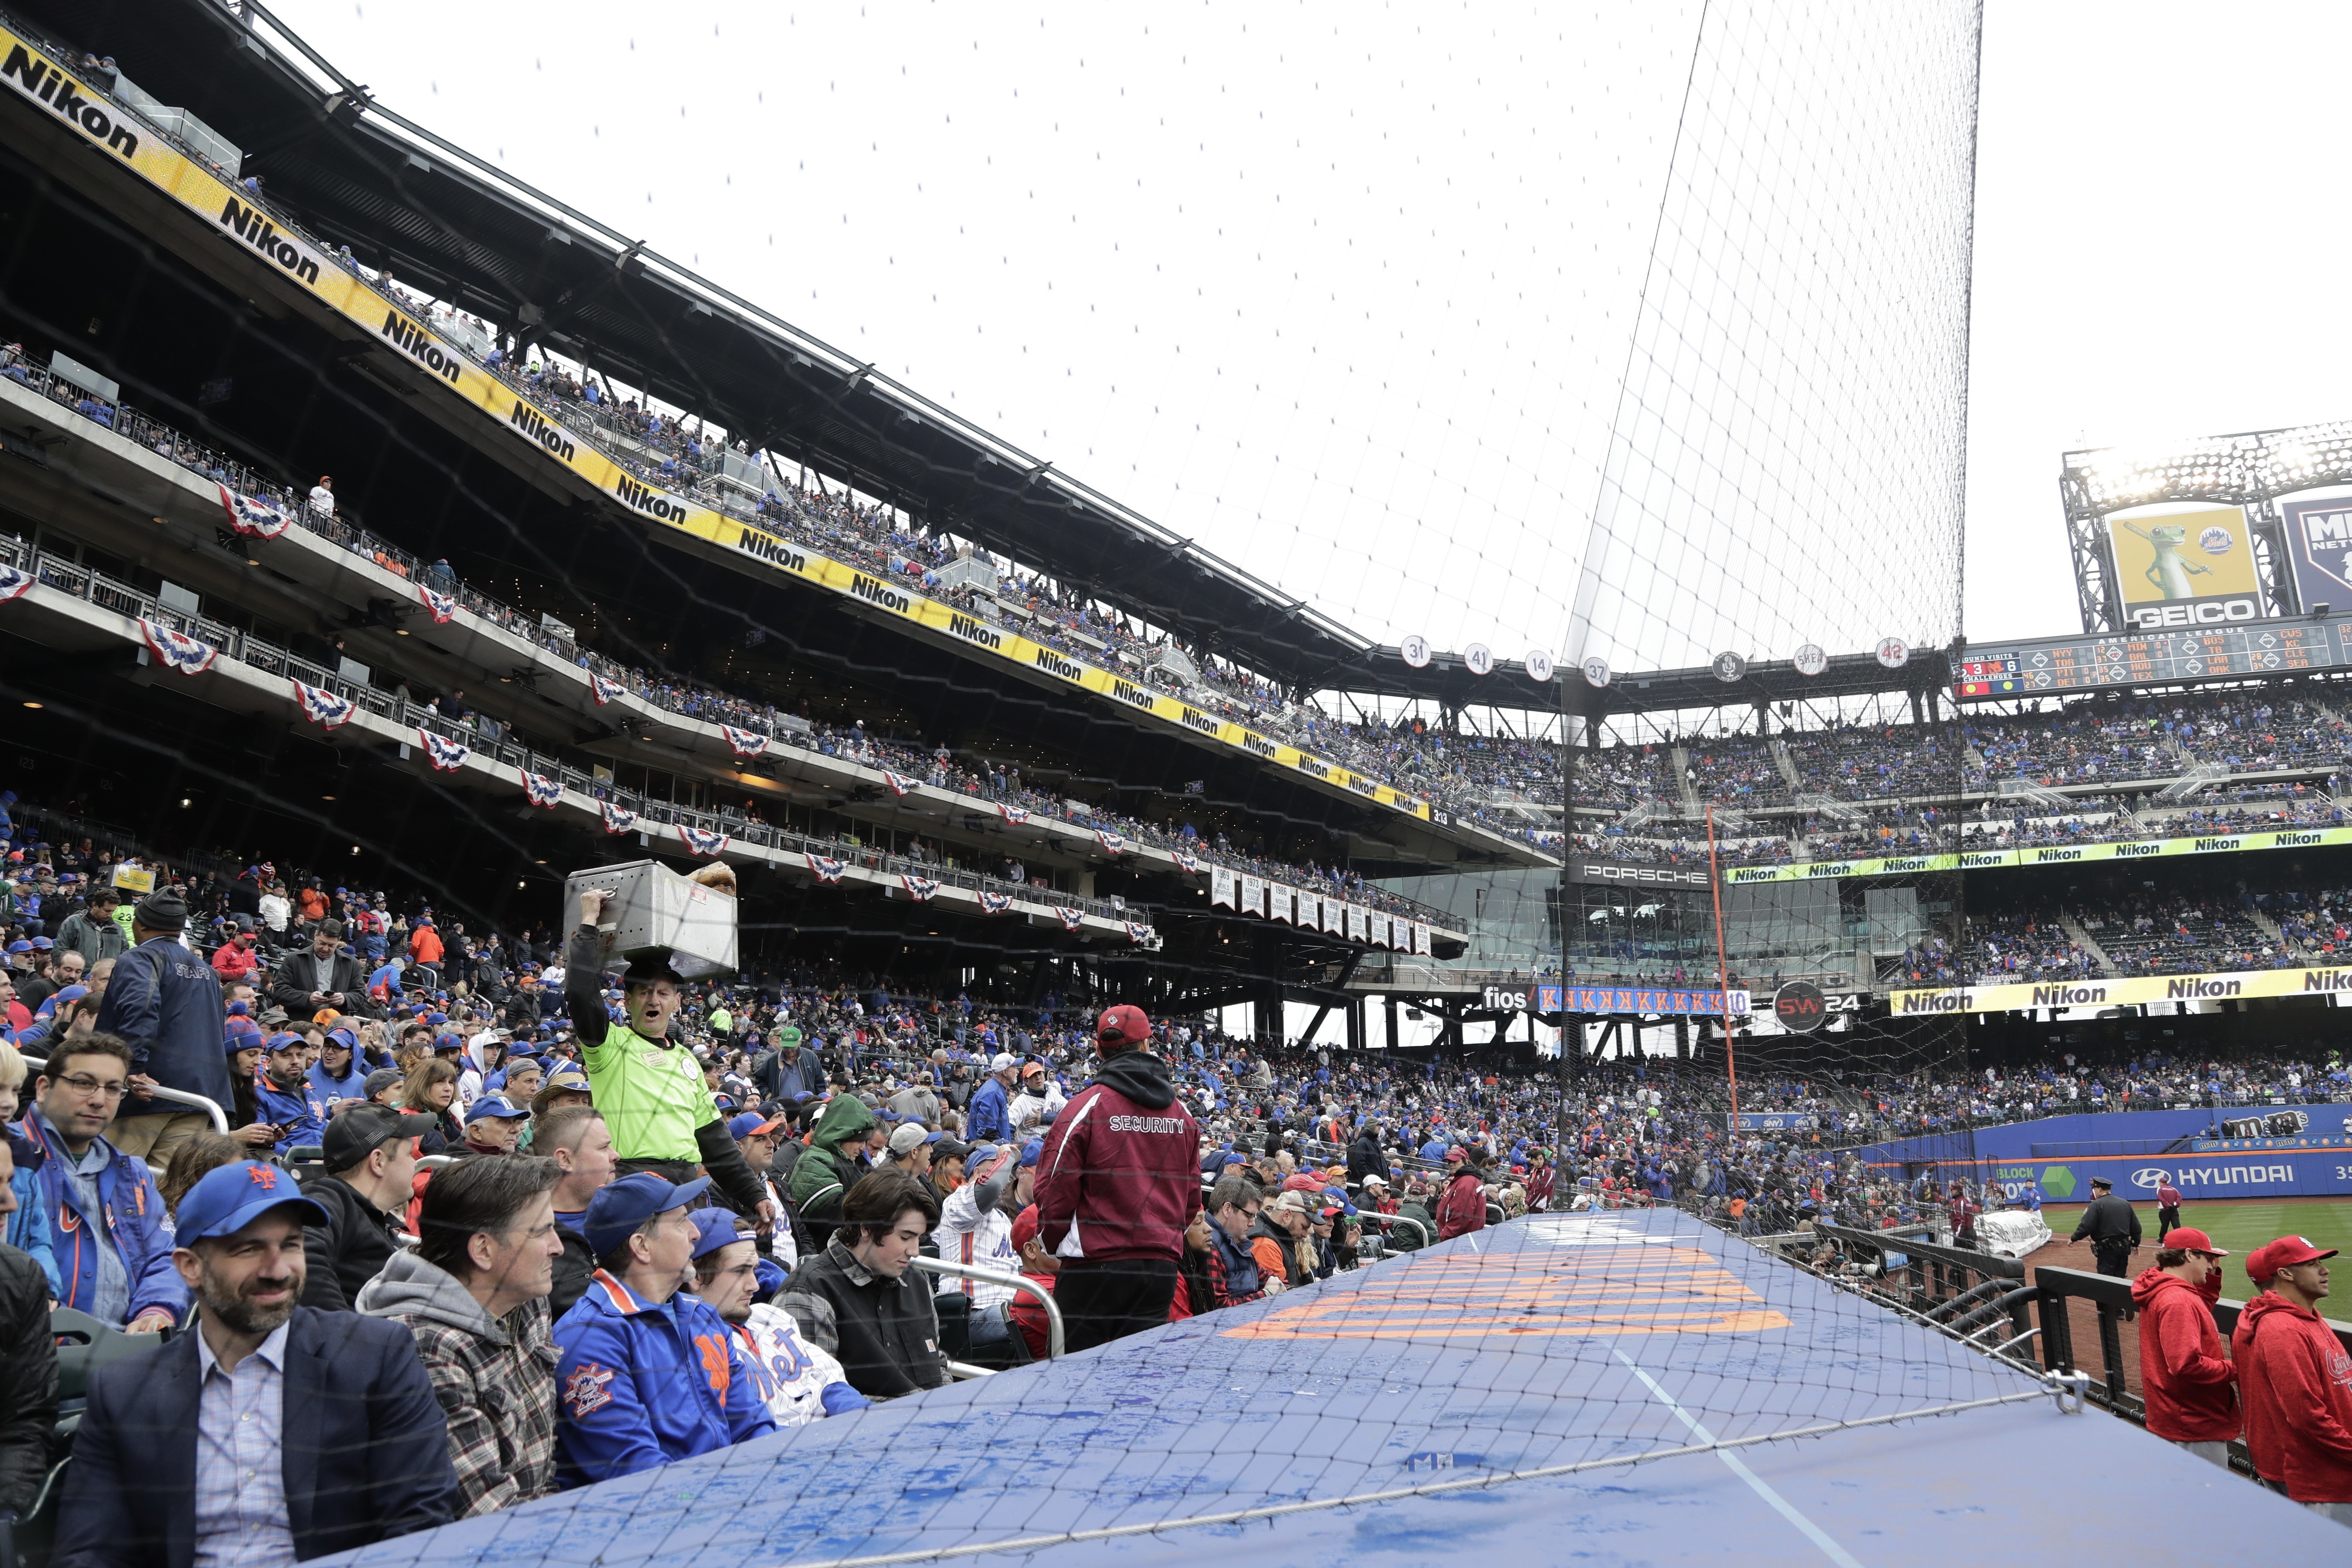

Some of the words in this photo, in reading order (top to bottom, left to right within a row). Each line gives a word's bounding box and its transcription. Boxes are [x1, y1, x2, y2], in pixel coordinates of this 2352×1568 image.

[1, 43, 138, 159] Nikon
[220, 196, 319, 285] Nikon
[382, 309, 460, 383] Nikon
[510, 400, 575, 463] Nikon
[616, 475, 686, 525] Nikon
[2205, 536, 2227, 548] Mets
[2312, 539, 2352, 550] NET
[739, 528, 805, 573] Nikon
[851, 574, 909, 613] Nikon
[2133, 600, 2255, 628] GEICO
[949, 614, 1000, 649] Nikon
[2098, 633, 2176, 645] AMERICAN
[2186, 627, 2244, 637] LEAGUE
[2280, 630, 2303, 638] CWS
[2203, 636, 2224, 645] BOS
[2285, 639, 2300, 648] KC
[1409, 644, 1424, 659] 31
[1882, 644, 1903, 659] 42
[2052, 649, 2073, 658] NYY
[2128, 643, 2147, 652] MIN
[2208, 646, 2222, 655] TB
[2285, 649, 2306, 658] CLE
[1472, 651, 1486, 665] 41
[1798, 652, 1822, 665] SHEA
[2055, 658, 2074, 667] TOR
[2129, 652, 2147, 661] BAL
[2208, 655, 2228, 664] LAA
[1037, 648, 1081, 681] Nikon
[1532, 658, 1545, 673] 14
[1973, 664, 1982, 674] 3
[2007, 661, 2016, 672] 6
[2131, 662, 2151, 671] HOU
[2209, 665, 2230, 674] OAK
[2286, 659, 2308, 668] SEA
[1589, 665, 1604, 680] 37
[1963, 674, 2012, 682] CHALLENGES
[2056, 668, 2074, 677] PIT
[2132, 671, 2153, 680] TEX
[2058, 678, 2076, 686] DET
[1113, 680, 1153, 709] Nikon
[1182, 707, 1218, 735] Nikon
[1244, 732, 1275, 758] Nikon
[1299, 754, 1328, 778] Nikon
[1349, 774, 1375, 797] Nikon
[1394, 793, 1418, 814] Nikon
[1433, 809, 1447, 825] 3:13
[2195, 838, 2239, 851] Nikon
[2276, 833, 2321, 845] Nikon
[2038, 849, 2081, 861] Nikon
[2116, 843, 2160, 856] Nikon
[1883, 859, 1926, 872] Nikon
[1958, 853, 2002, 867] Nikon
[1217, 868, 1230, 880] 1969
[1584, 865, 1708, 884] PORSCHE
[1735, 869, 1776, 881] Nikon
[1809, 864, 1850, 876] Nikon
[1247, 877, 1259, 888] 1973
[1213, 888, 1233, 898] CHAMPIONS
[1245, 888, 1260, 897] NATIONAL
[1275, 885, 1287, 896] 1986
[1302, 892, 1313, 903] 1988
[1243, 899, 1262, 909] CHAMPIONS
[1272, 904, 1290, 913] CHAMPIONS
[1327, 900, 1338, 910] 1999
[1351, 906, 1361, 916] 2000
[1299, 914, 1317, 923] CHAMPIONS
[1375, 913, 1384, 922] 2006
[1397, 919, 1406, 928] 2015
[1349, 926, 1365, 935] CHAMPIONS
[1418, 925, 1427, 934] 2016
[175, 963, 210, 980] STAFF
[2167, 978, 2241, 998] Nikon
[1484, 986, 1527, 1009] fios
[1541, 989, 1559, 1008] K
[2033, 985, 2106, 1005] Nikon
[1728, 992, 1746, 1014] 10
[1903, 992, 1972, 1012] Nikon
[1109, 1115, 1184, 1134] SECURITY
[1996, 1167, 2034, 1179] BLOCK
[2178, 1165, 2294, 1185] HYUNDAI
